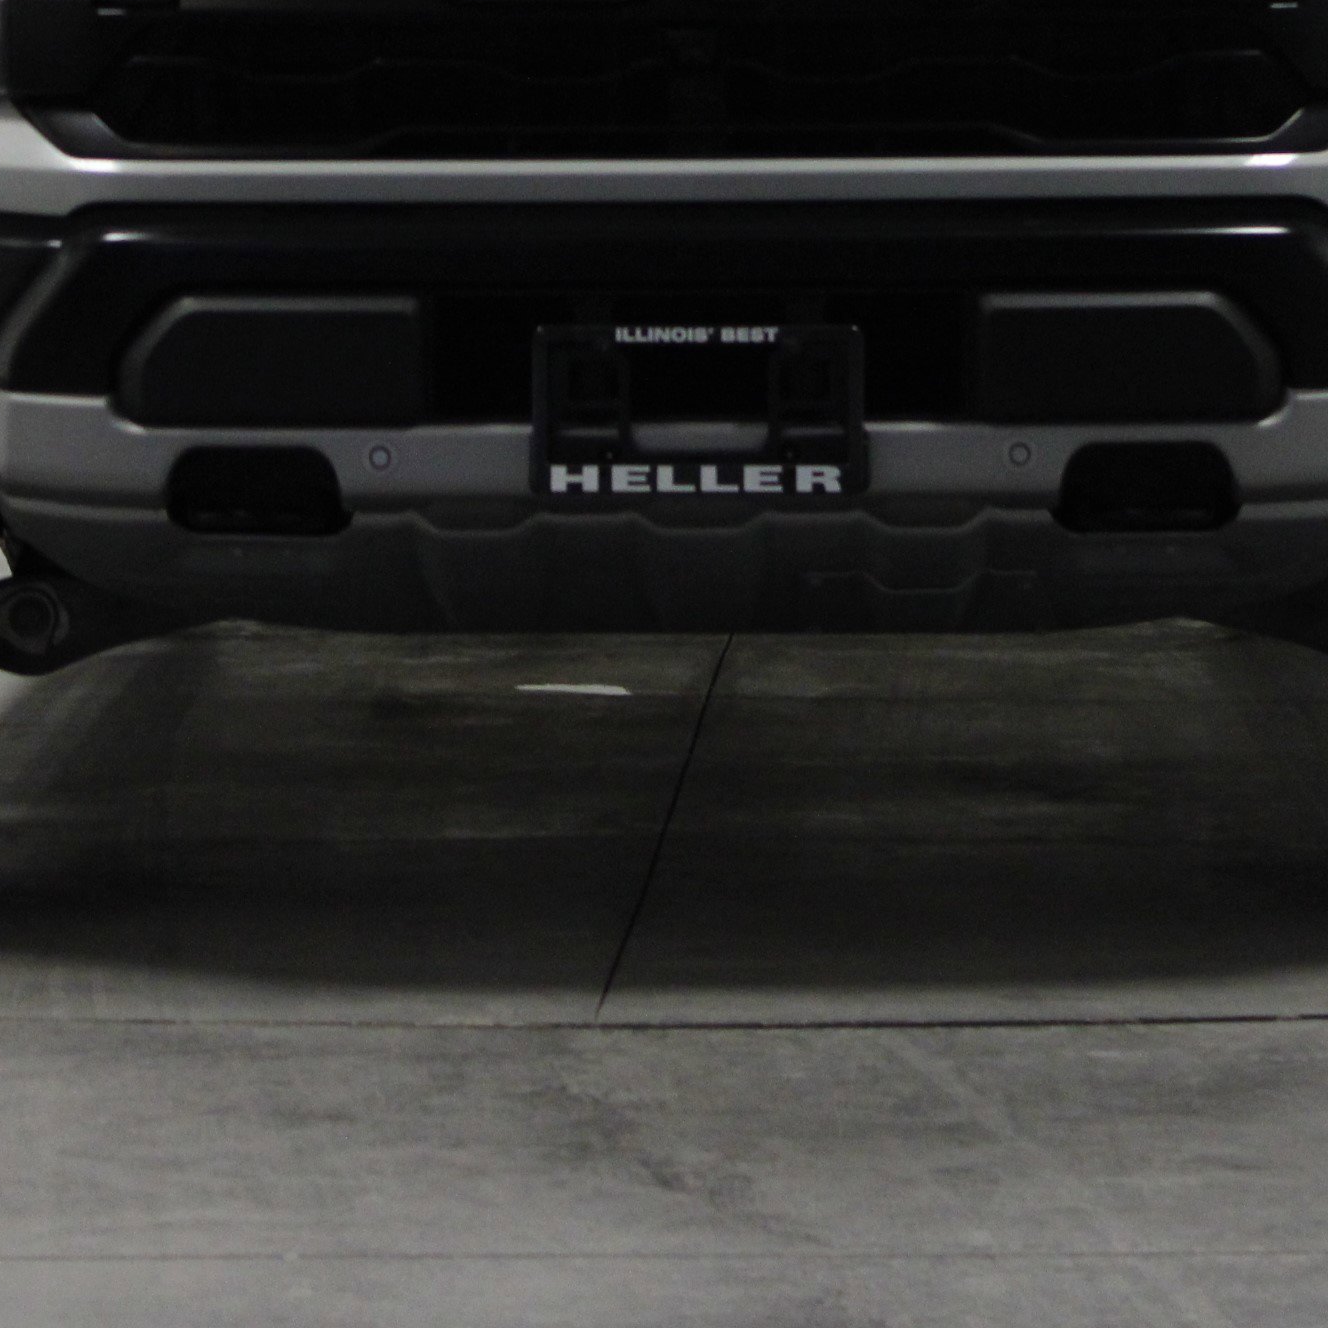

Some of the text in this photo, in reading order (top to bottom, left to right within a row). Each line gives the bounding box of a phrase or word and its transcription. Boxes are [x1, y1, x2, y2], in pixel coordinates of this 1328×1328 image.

[615, 326, 779, 343] ILLINOIS' BEST
[549, 465, 843, 493] HELLER
